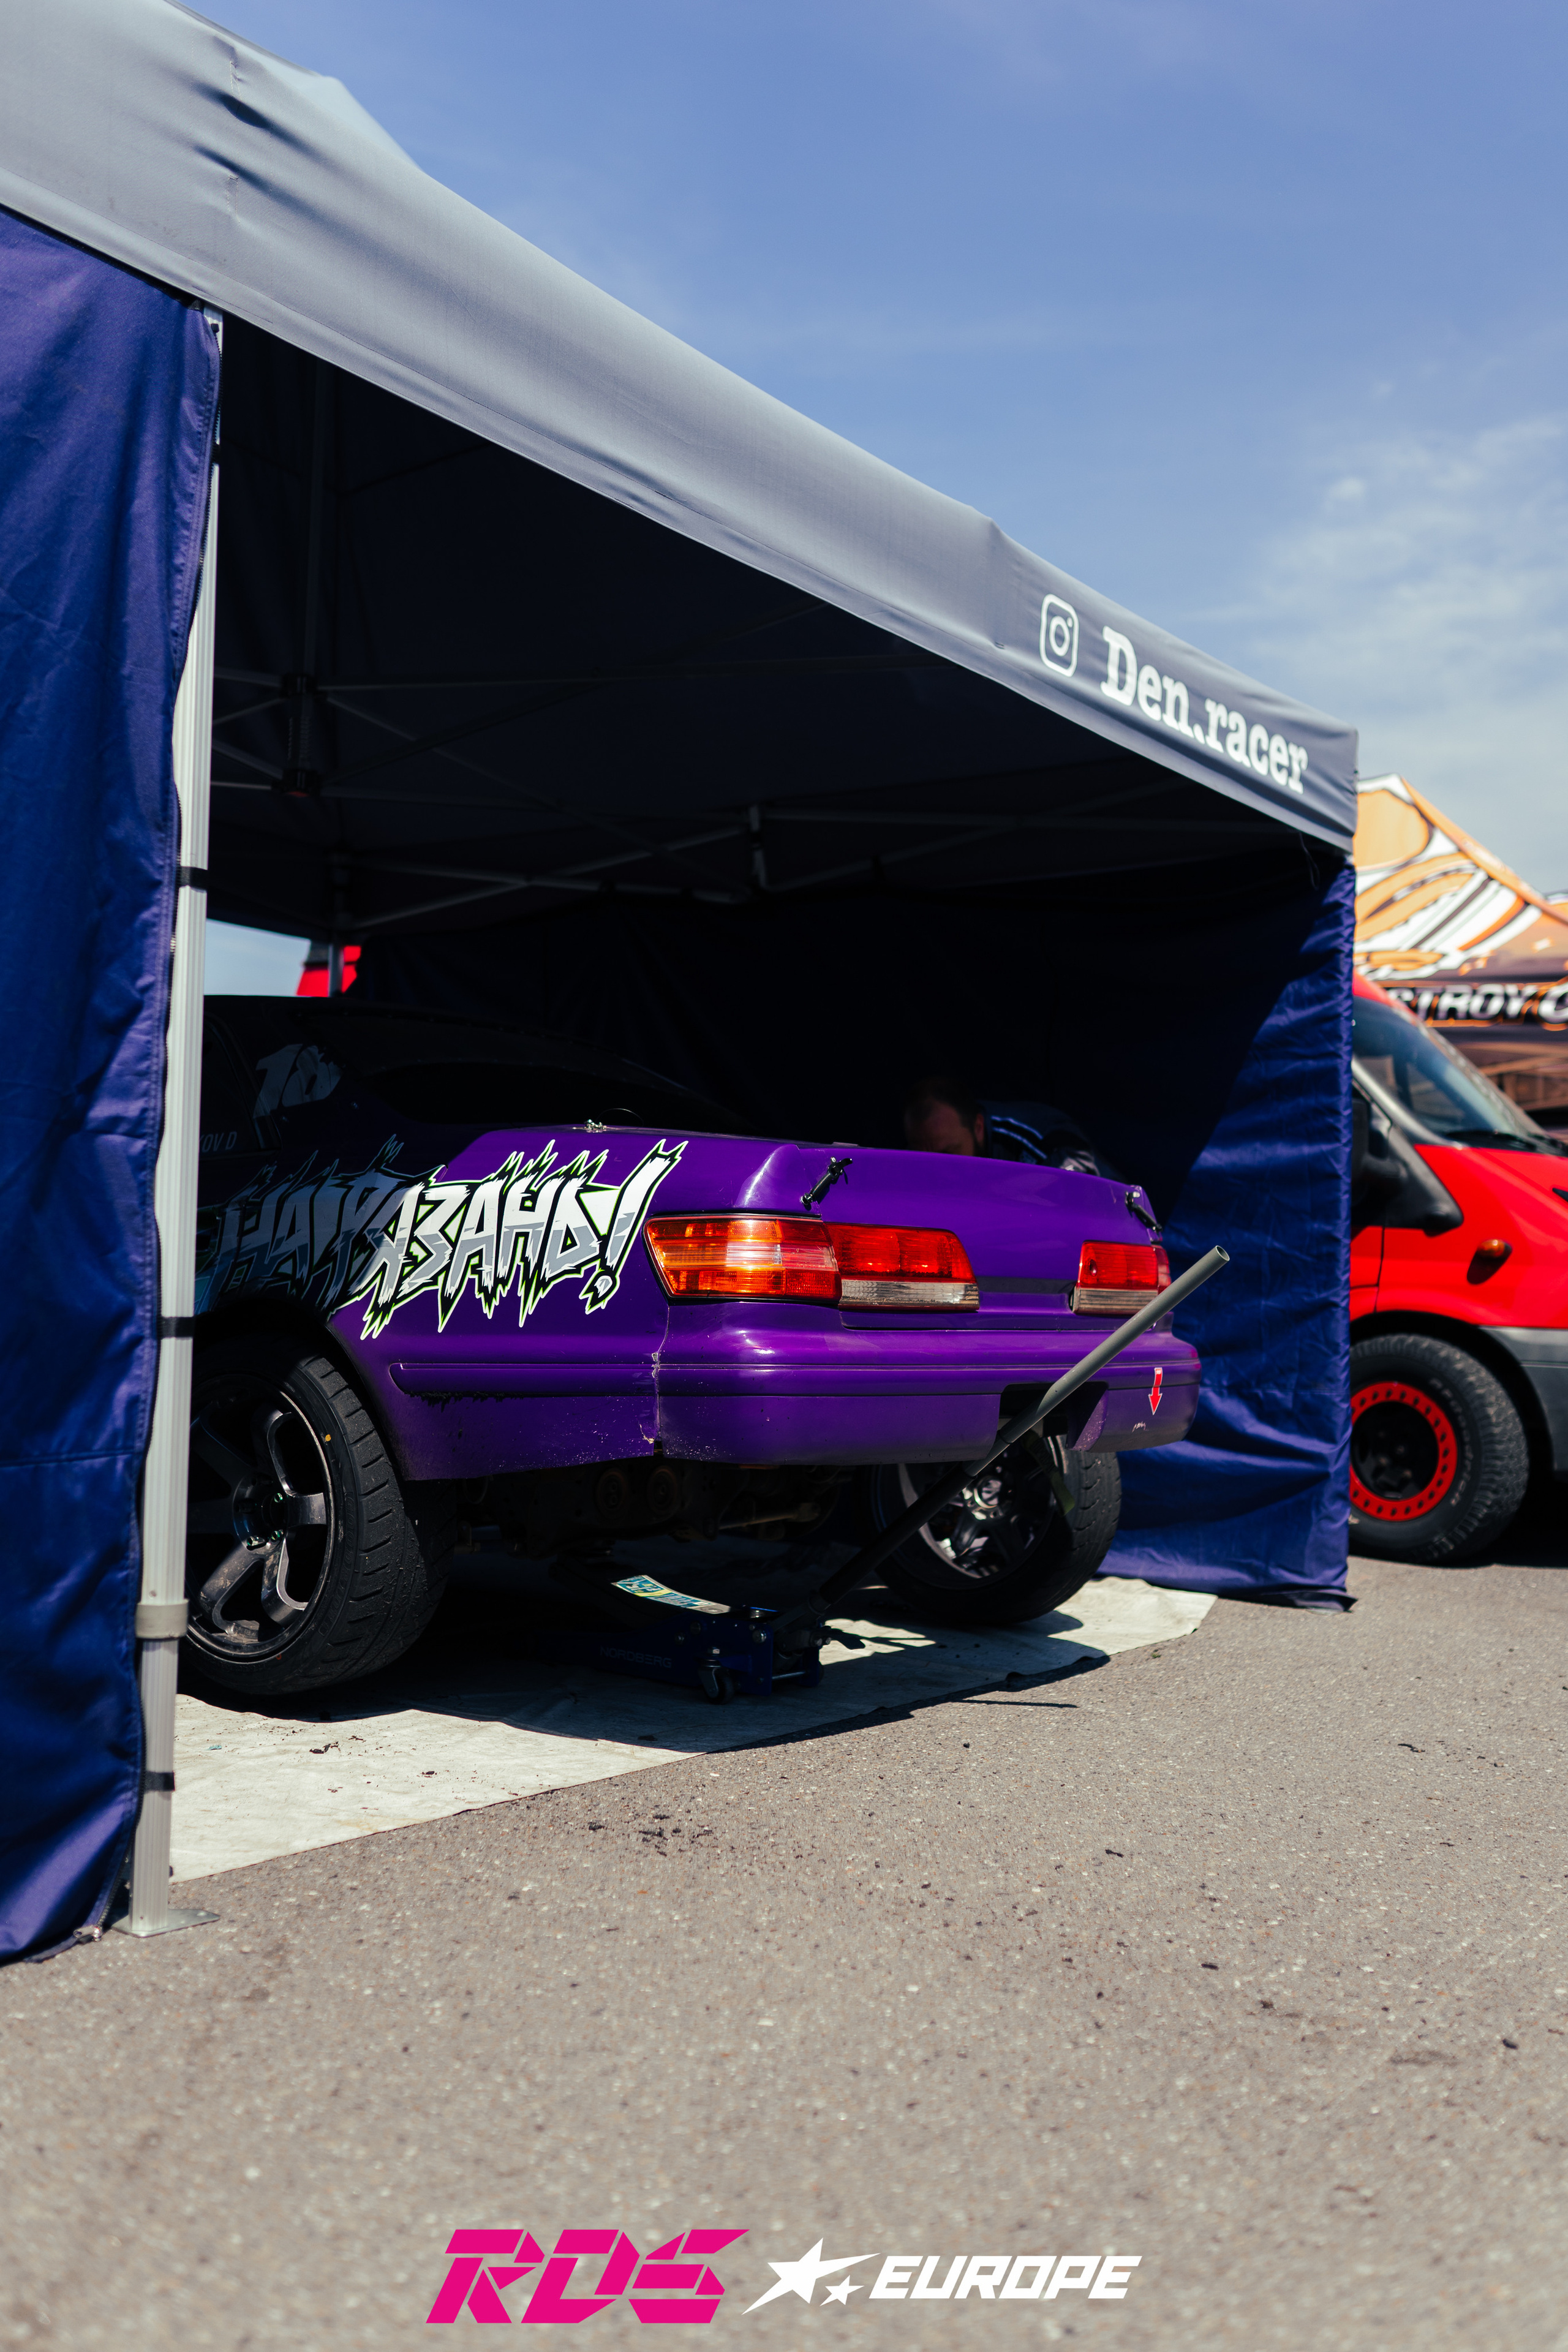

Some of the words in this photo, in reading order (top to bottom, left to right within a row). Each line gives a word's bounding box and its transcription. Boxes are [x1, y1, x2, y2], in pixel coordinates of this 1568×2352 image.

[1101, 626, 1308, 794] Den.racer
[200, 1133, 225, 1153] OV
[600, 1646, 673, 1669] NORDBERG
